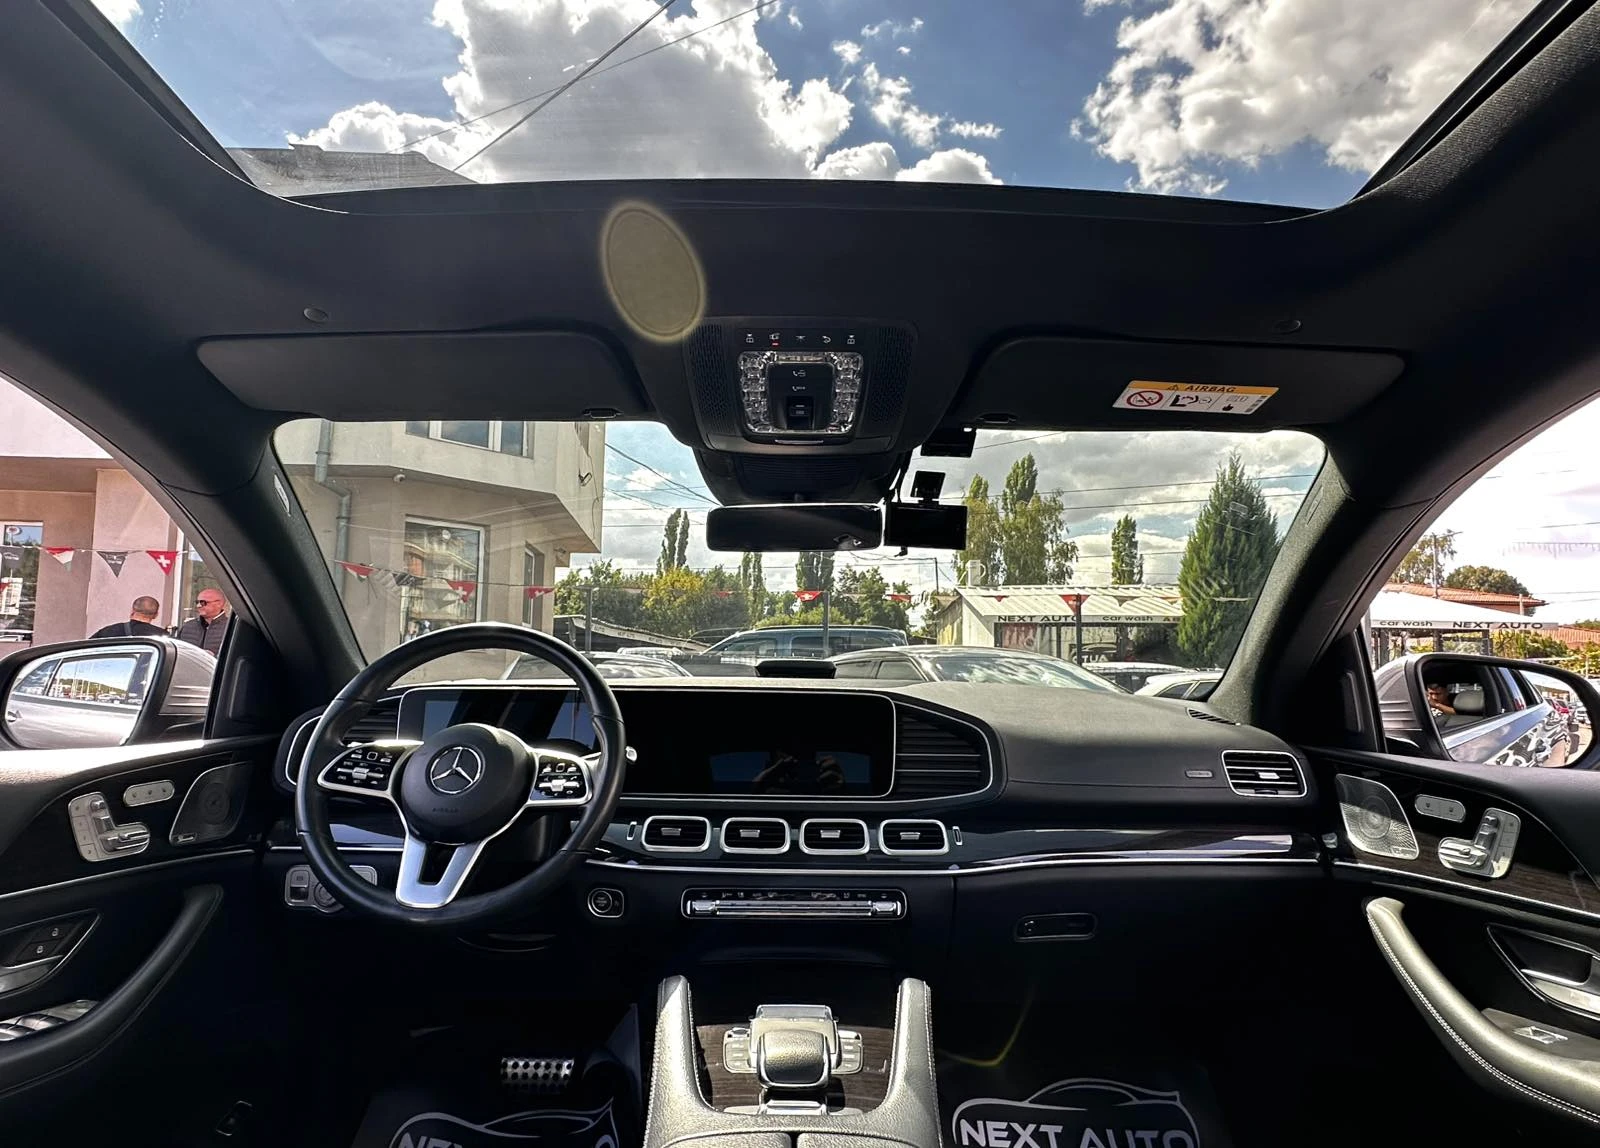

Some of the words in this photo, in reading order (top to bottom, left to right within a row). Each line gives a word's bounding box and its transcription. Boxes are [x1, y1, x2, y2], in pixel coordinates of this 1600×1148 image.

[1184, 384, 1236, 393] AIRBAG
[1452, 621, 1494, 629] NEXT
[1498, 622, 1543, 630] AUTO
[959, 1118, 1063, 1148] NEXT
[1079, 1127, 1195, 1148] AUTO
